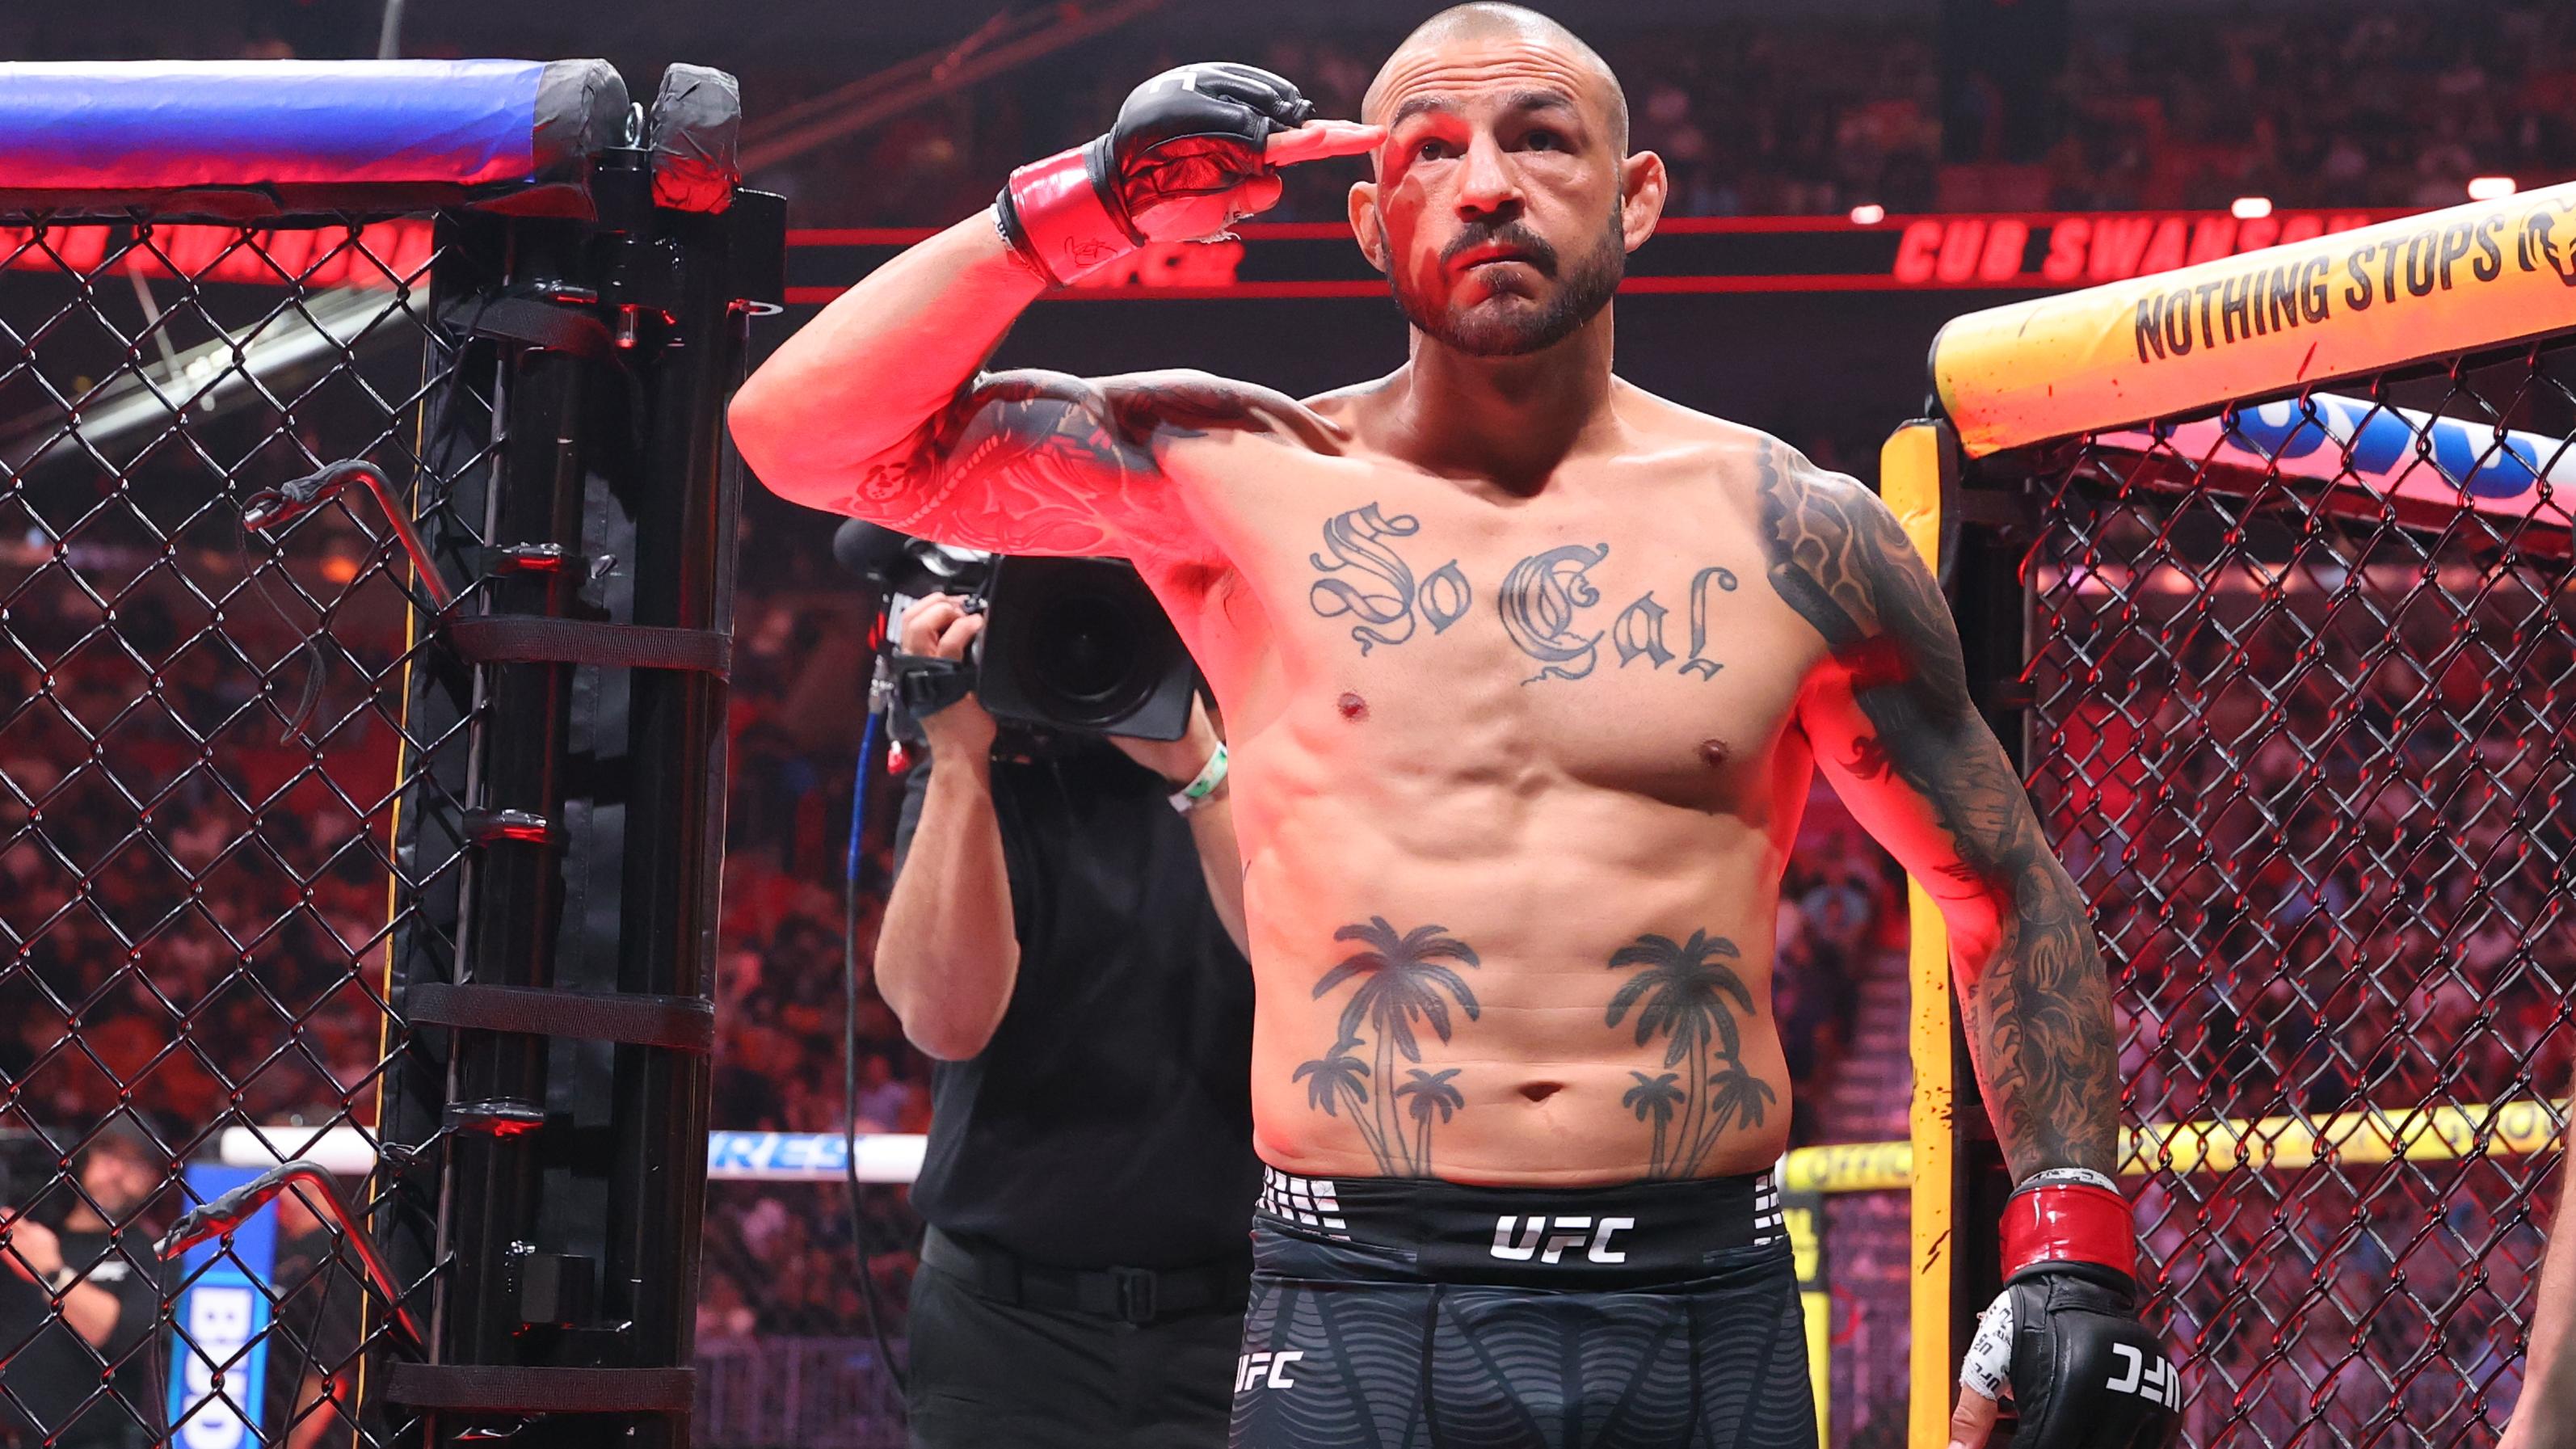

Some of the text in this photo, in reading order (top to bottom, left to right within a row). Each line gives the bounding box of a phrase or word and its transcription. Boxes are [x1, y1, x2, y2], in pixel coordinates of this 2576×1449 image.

[1893, 217, 2029, 284] CUB
[2135, 213, 2506, 364] NOTHING STOPS
[1310, 501, 1738, 687] So Cal
[1490, 1215, 1635, 1264] UFC
[1234, 1350, 1304, 1393] UFC
[2106, 1342, 2181, 1413] UFC
